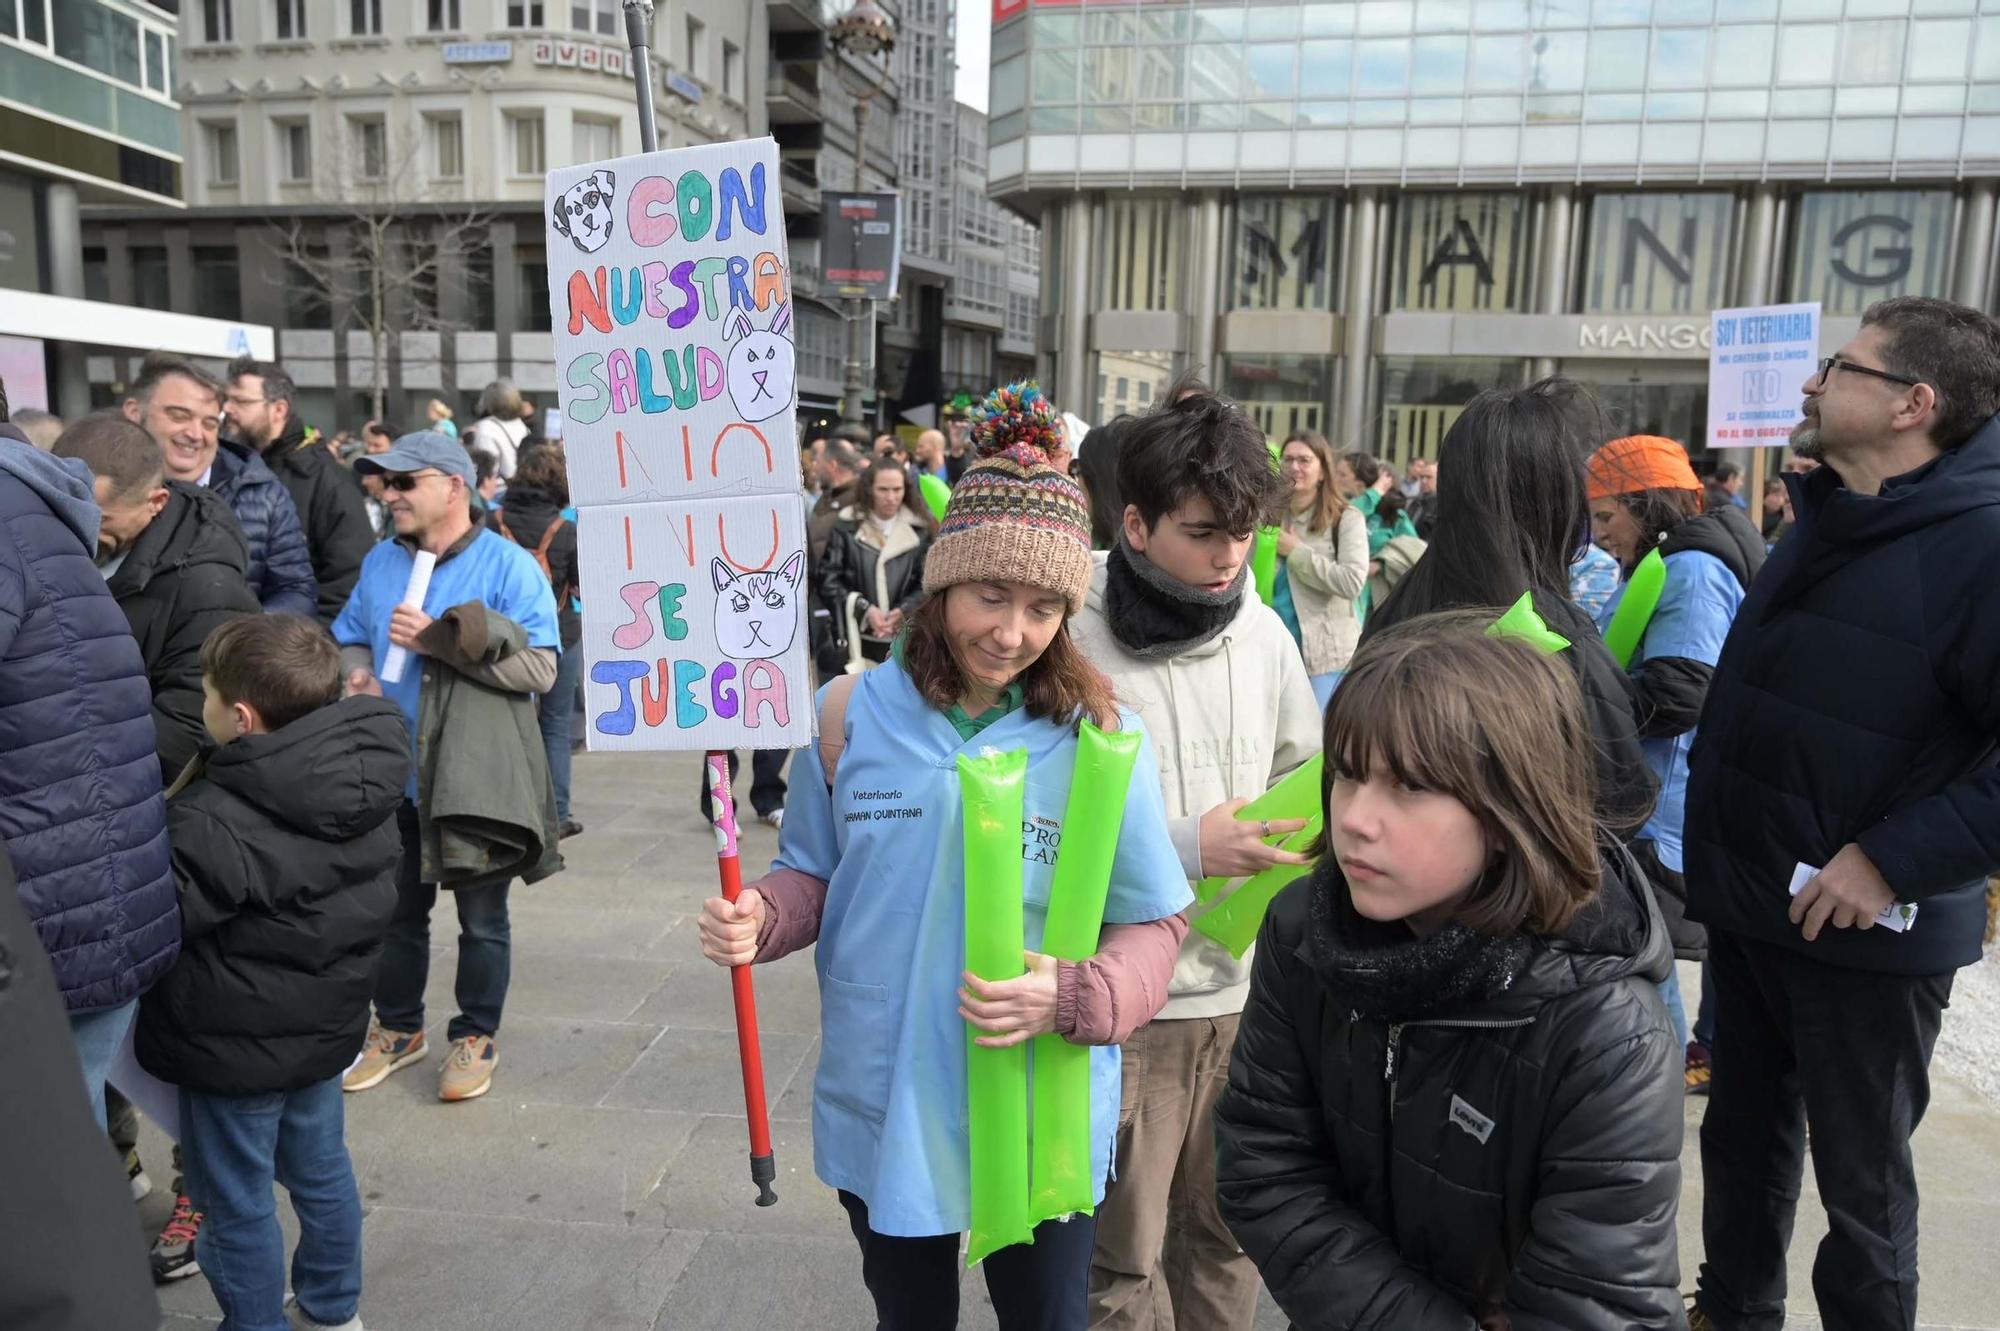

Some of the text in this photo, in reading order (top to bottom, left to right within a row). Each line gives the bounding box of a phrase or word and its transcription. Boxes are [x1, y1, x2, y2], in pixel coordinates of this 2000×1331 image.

[627, 162, 767, 247] CON
[567, 252, 785, 335] NUESTRA
[1717, 313, 1812, 346] SOY VETERINARIA
[567, 344, 725, 424] SALUD
[1742, 368, 1781, 405] NO
[612, 581, 688, 650] SE
[590, 657, 791, 736] JUEGA
[853, 789, 903, 801] Veterinario
[873, 808, 923, 821] QUINTANA
[1022, 821, 1062, 848] PRO
